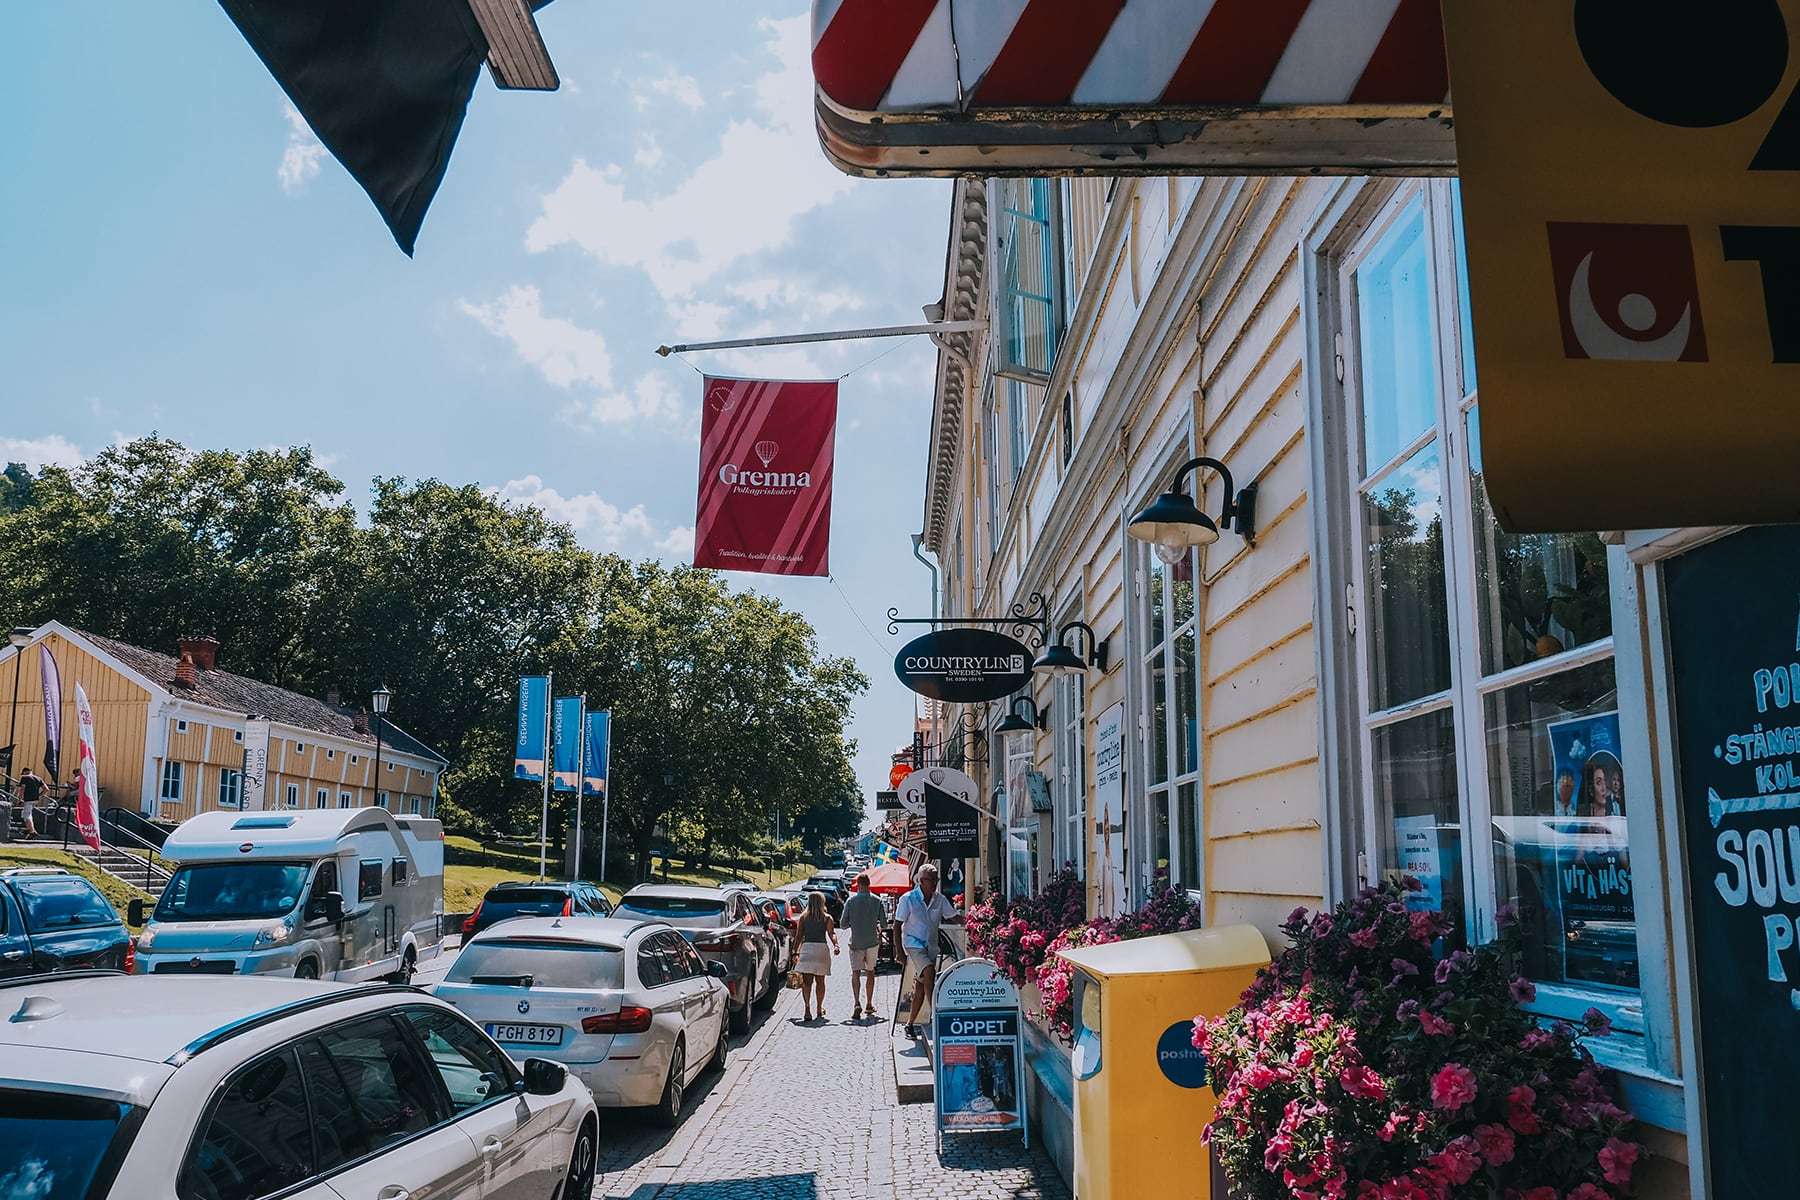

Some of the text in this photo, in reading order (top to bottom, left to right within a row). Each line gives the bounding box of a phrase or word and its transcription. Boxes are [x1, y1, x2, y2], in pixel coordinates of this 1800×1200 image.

[719, 463, 811, 488] Grenna
[733, 486, 797, 496] Polkagriskokeri
[904, 656, 1024, 670] COUNTRYLINE
[256, 748, 266, 790] GRENNA
[929, 828, 976, 836] countryline
[1408, 862, 1432, 872] REA 50%
[1564, 856, 1632, 899] VITA HÄS
[948, 986, 1006, 996] countryline
[950, 1018, 1007, 1034] ÖPPET
[496, 1026, 556, 1041] FGH 819
